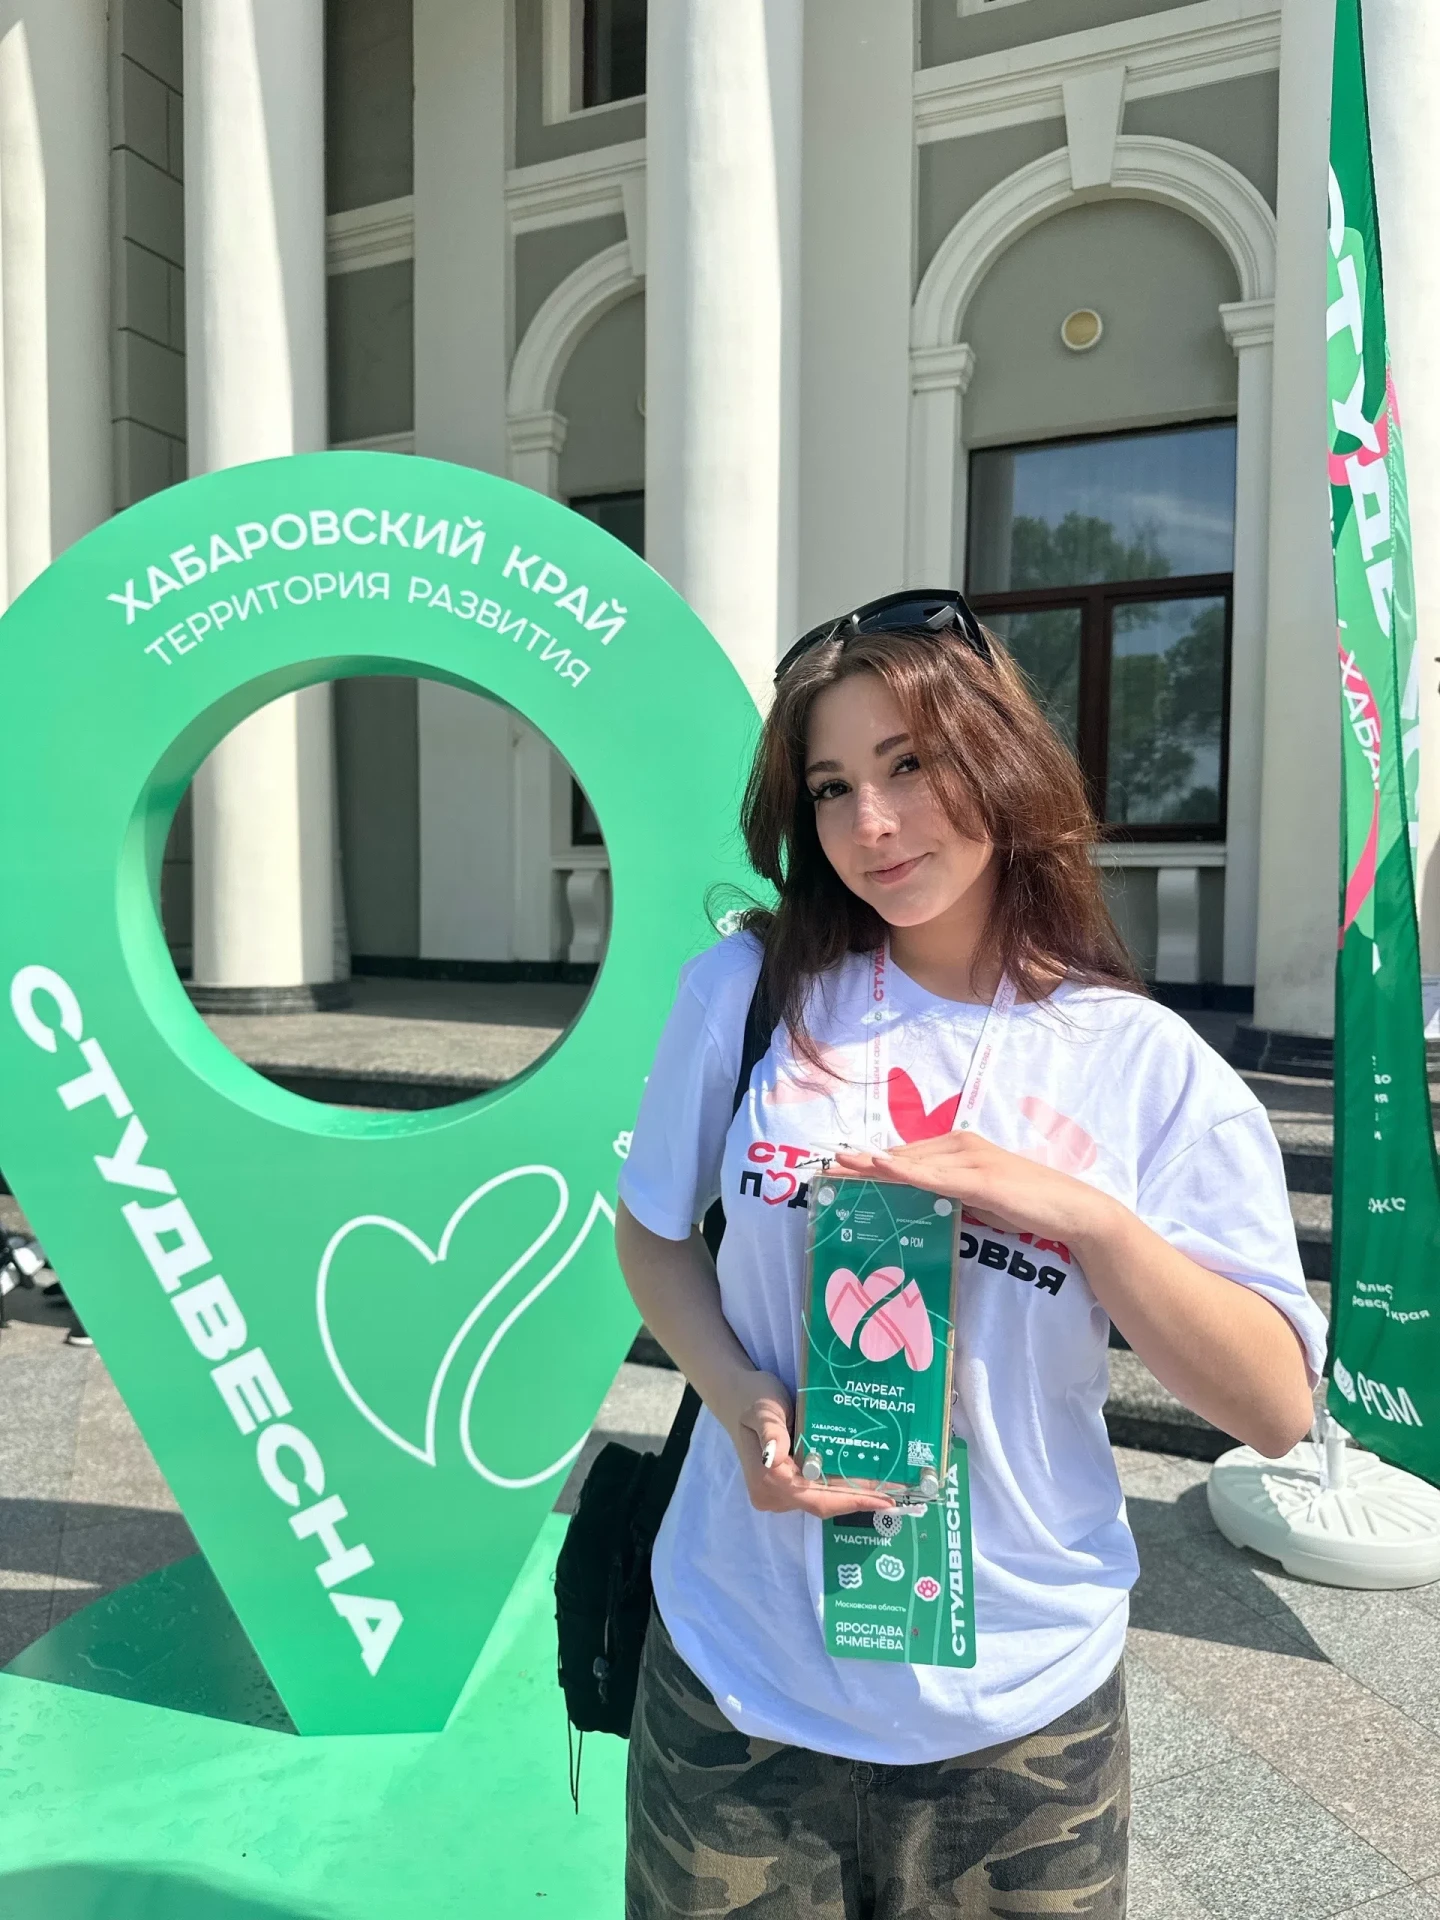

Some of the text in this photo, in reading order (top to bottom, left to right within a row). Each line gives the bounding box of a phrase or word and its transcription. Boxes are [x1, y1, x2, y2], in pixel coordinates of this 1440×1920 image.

[107, 507, 628, 646] ХАБАРОВСКИЙ КРАЙ
[143, 571, 591, 688] ТЕРРИТОРИЯ РАЗВИТИЯ
[910, 1236, 924, 1248] РСМ
[9, 964, 404, 1677] СТУДВЕСНА
[844, 1381, 905, 1398] ЛАУРЕАТ
[833, 1393, 916, 1414] ФЕСТИВАЛЯ
[1357, 1371, 1424, 1427] РСМ
[811, 1423, 847, 1432] ХАБАРОВСК
[810, 1434, 890, 1451] СТУДВЕСНА
[833, 1533, 892, 1547] УЧАСТНИК
[946, 1463, 967, 1657] СТУДВЕСНА
[835, 1600, 907, 1613] Московская область
[835, 1621, 904, 1638] ЯРОСЛАВА
[835, 1635, 904, 1651] ЯЧМЕНЁВА
